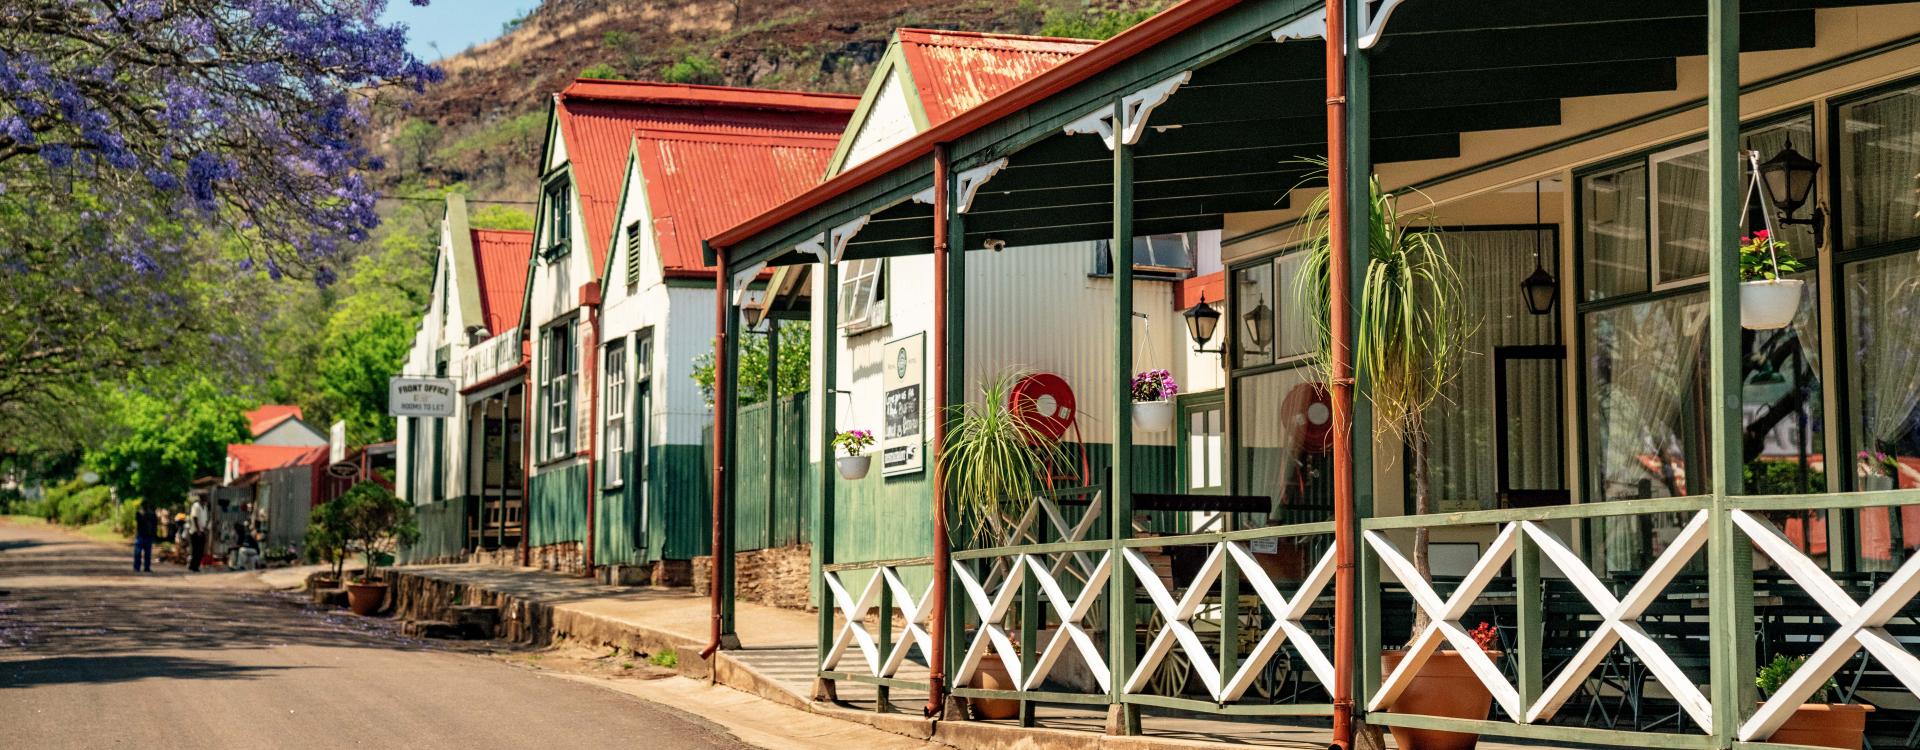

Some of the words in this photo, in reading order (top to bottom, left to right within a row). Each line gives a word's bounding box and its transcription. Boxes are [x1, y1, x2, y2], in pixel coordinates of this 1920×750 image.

[398, 384, 423, 395] FRONT
[424, 384, 449, 396] OFFICE
[401, 402, 422, 410] ROOMS
